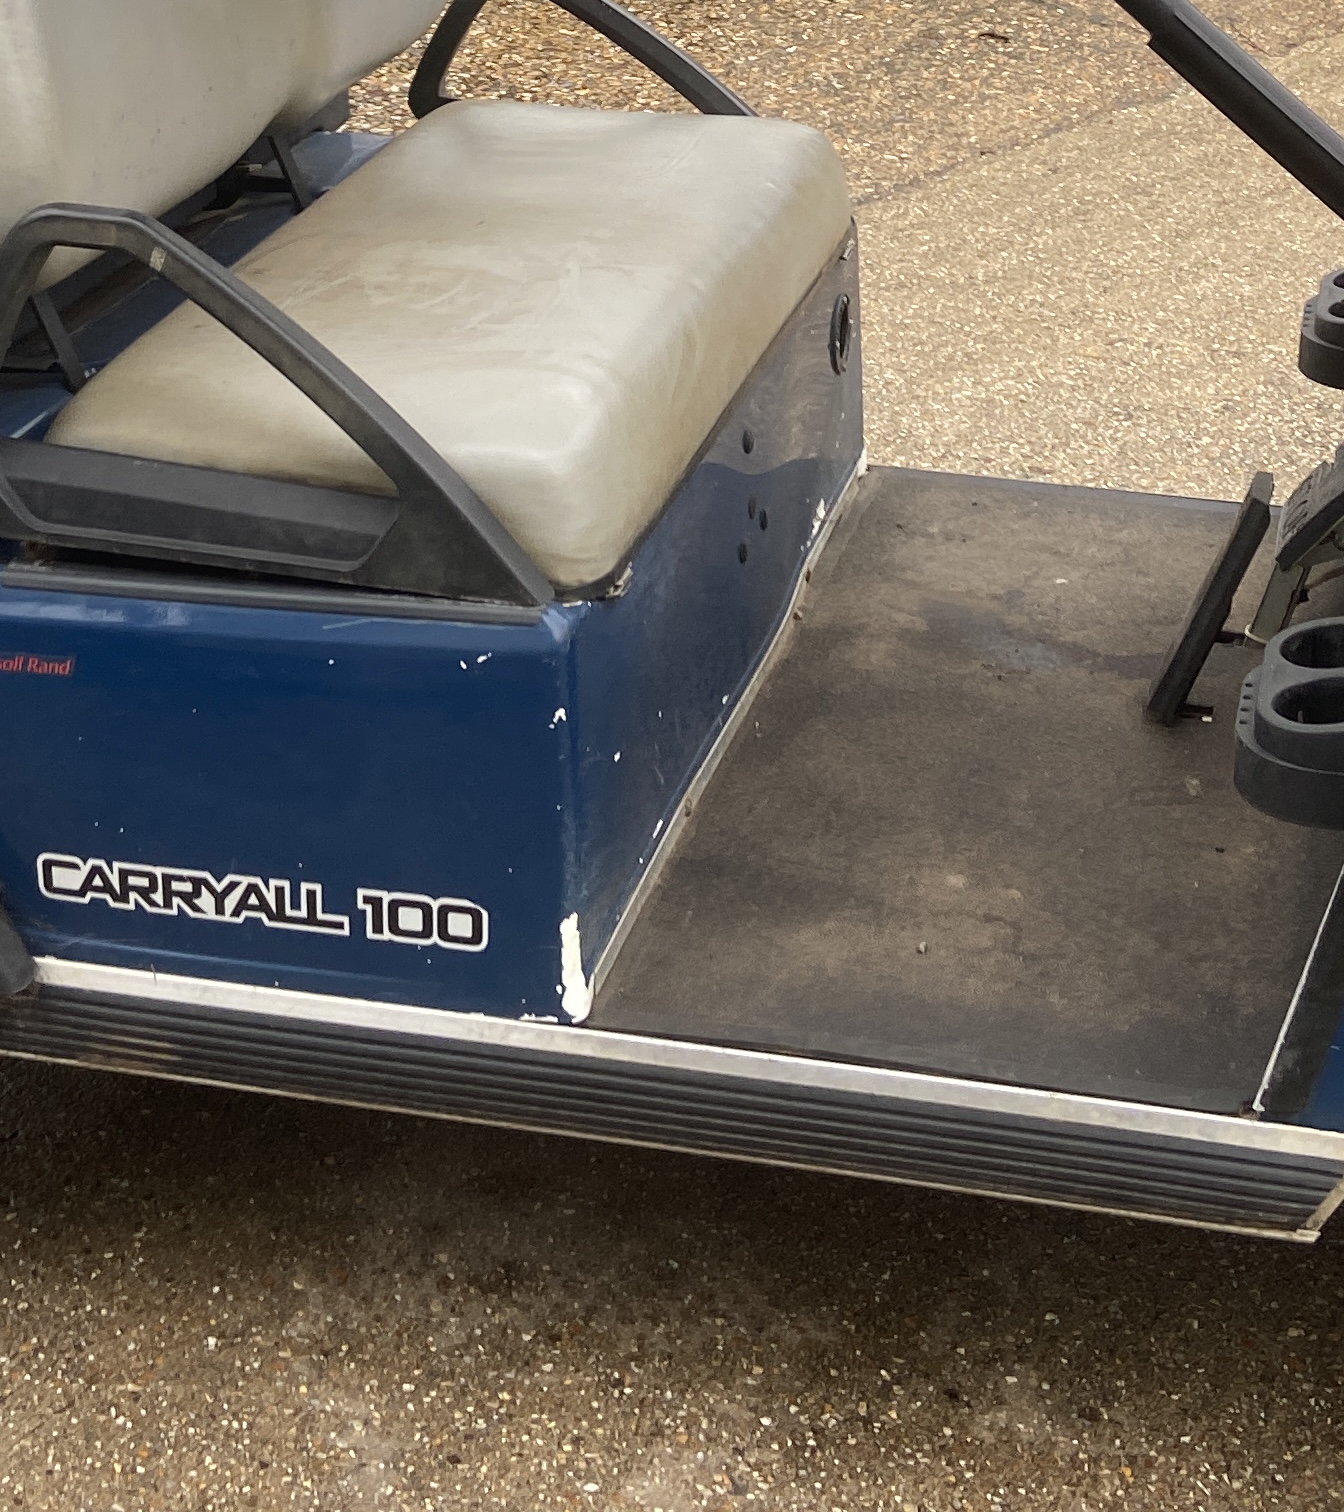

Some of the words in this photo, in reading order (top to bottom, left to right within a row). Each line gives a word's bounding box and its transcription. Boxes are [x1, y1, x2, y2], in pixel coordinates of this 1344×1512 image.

[27, 656, 72, 676] Rand
[39, 854, 350, 935] CARRYALL
[359, 888, 487, 951] 100
